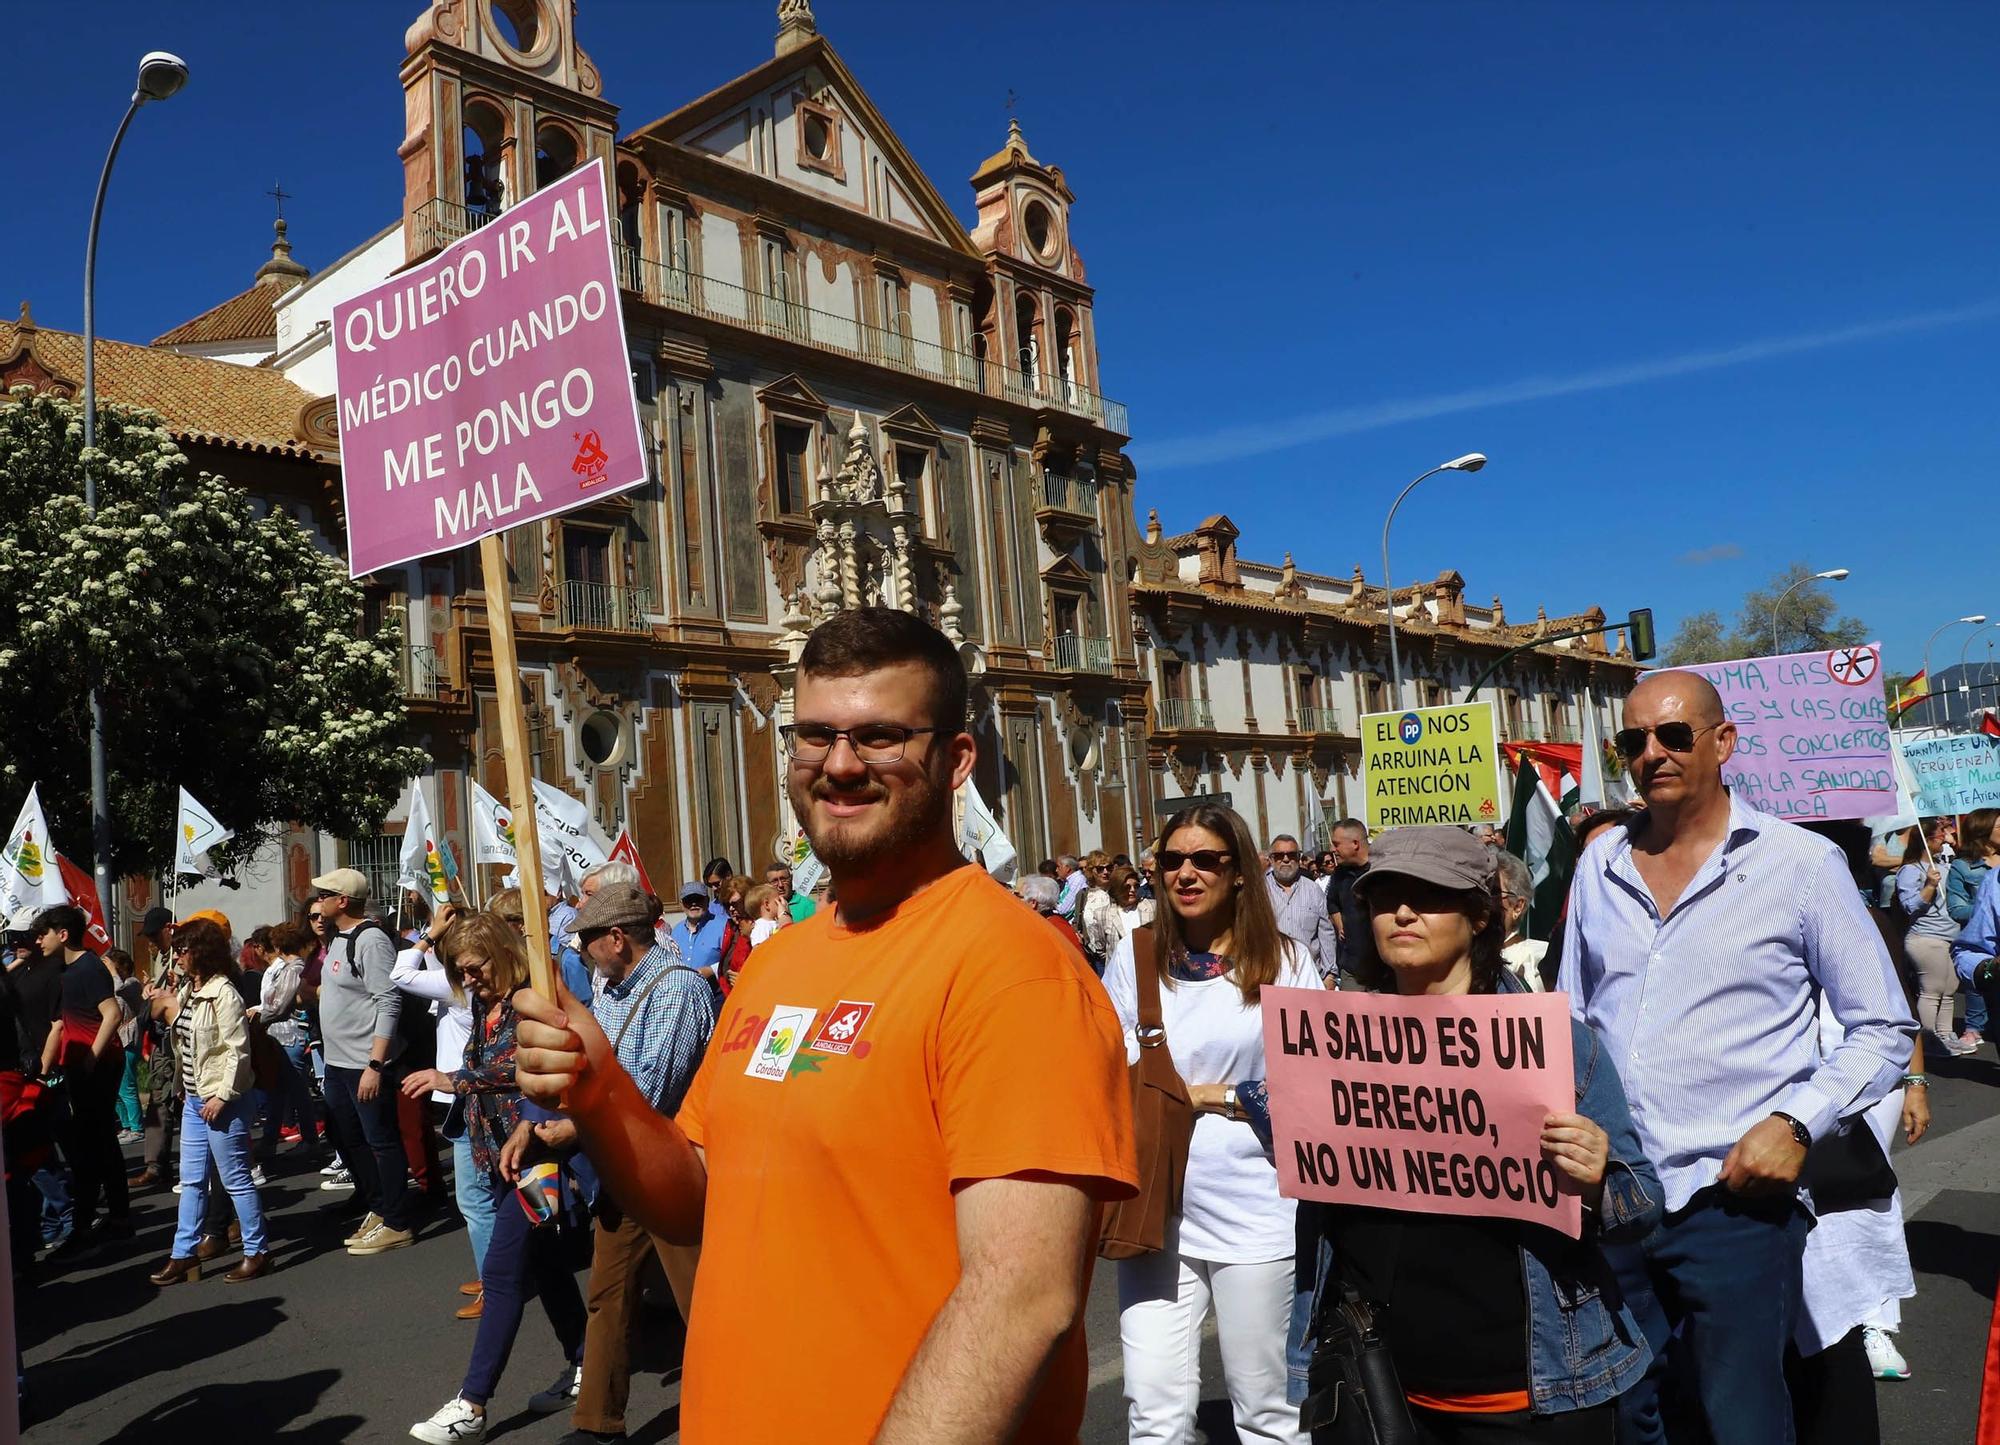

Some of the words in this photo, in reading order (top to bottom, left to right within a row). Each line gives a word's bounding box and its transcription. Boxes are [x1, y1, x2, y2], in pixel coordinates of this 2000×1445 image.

[345, 249, 487, 353] QUIERO
[499, 220, 536, 279] IR
[548, 187, 601, 253] AL
[344, 355, 461, 431] MÉDICO
[468, 281, 606, 376] CUANDO
[383, 433, 445, 491] ME
[456, 368, 594, 467] PONGO
[435, 462, 542, 539] MALA
[1778, 661, 1831, 685] LAS
[1791, 699, 1835, 720] LAS
[1377, 723, 1395, 741] EL
[1428, 713, 1469, 734] NOS
[1780, 729, 1890, 755] CONCIERTOS
[1371, 747, 1451, 771] ARRUINA
[1458, 745, 1482, 764] LA
[1376, 769, 1470, 796] ATENCIÓN
[1724, 768, 1763, 795] ARA
[1769, 772, 1795, 792] LA
[1380, 803, 1472, 825] PRIMARIA
[1280, 1008, 1318, 1057] LA
[1325, 1012, 1427, 1064] SALUD
[1436, 1017, 1480, 1068] ES
[1491, 1016, 1546, 1069] UN
[755, 1062, 785, 1077] Córdoba
[1331, 1079, 1498, 1148] DERECHO,
[1294, 1141, 1340, 1187] NO
[1348, 1146, 1397, 1192] UN
[1403, 1149, 1558, 1209] NEGOCIO
